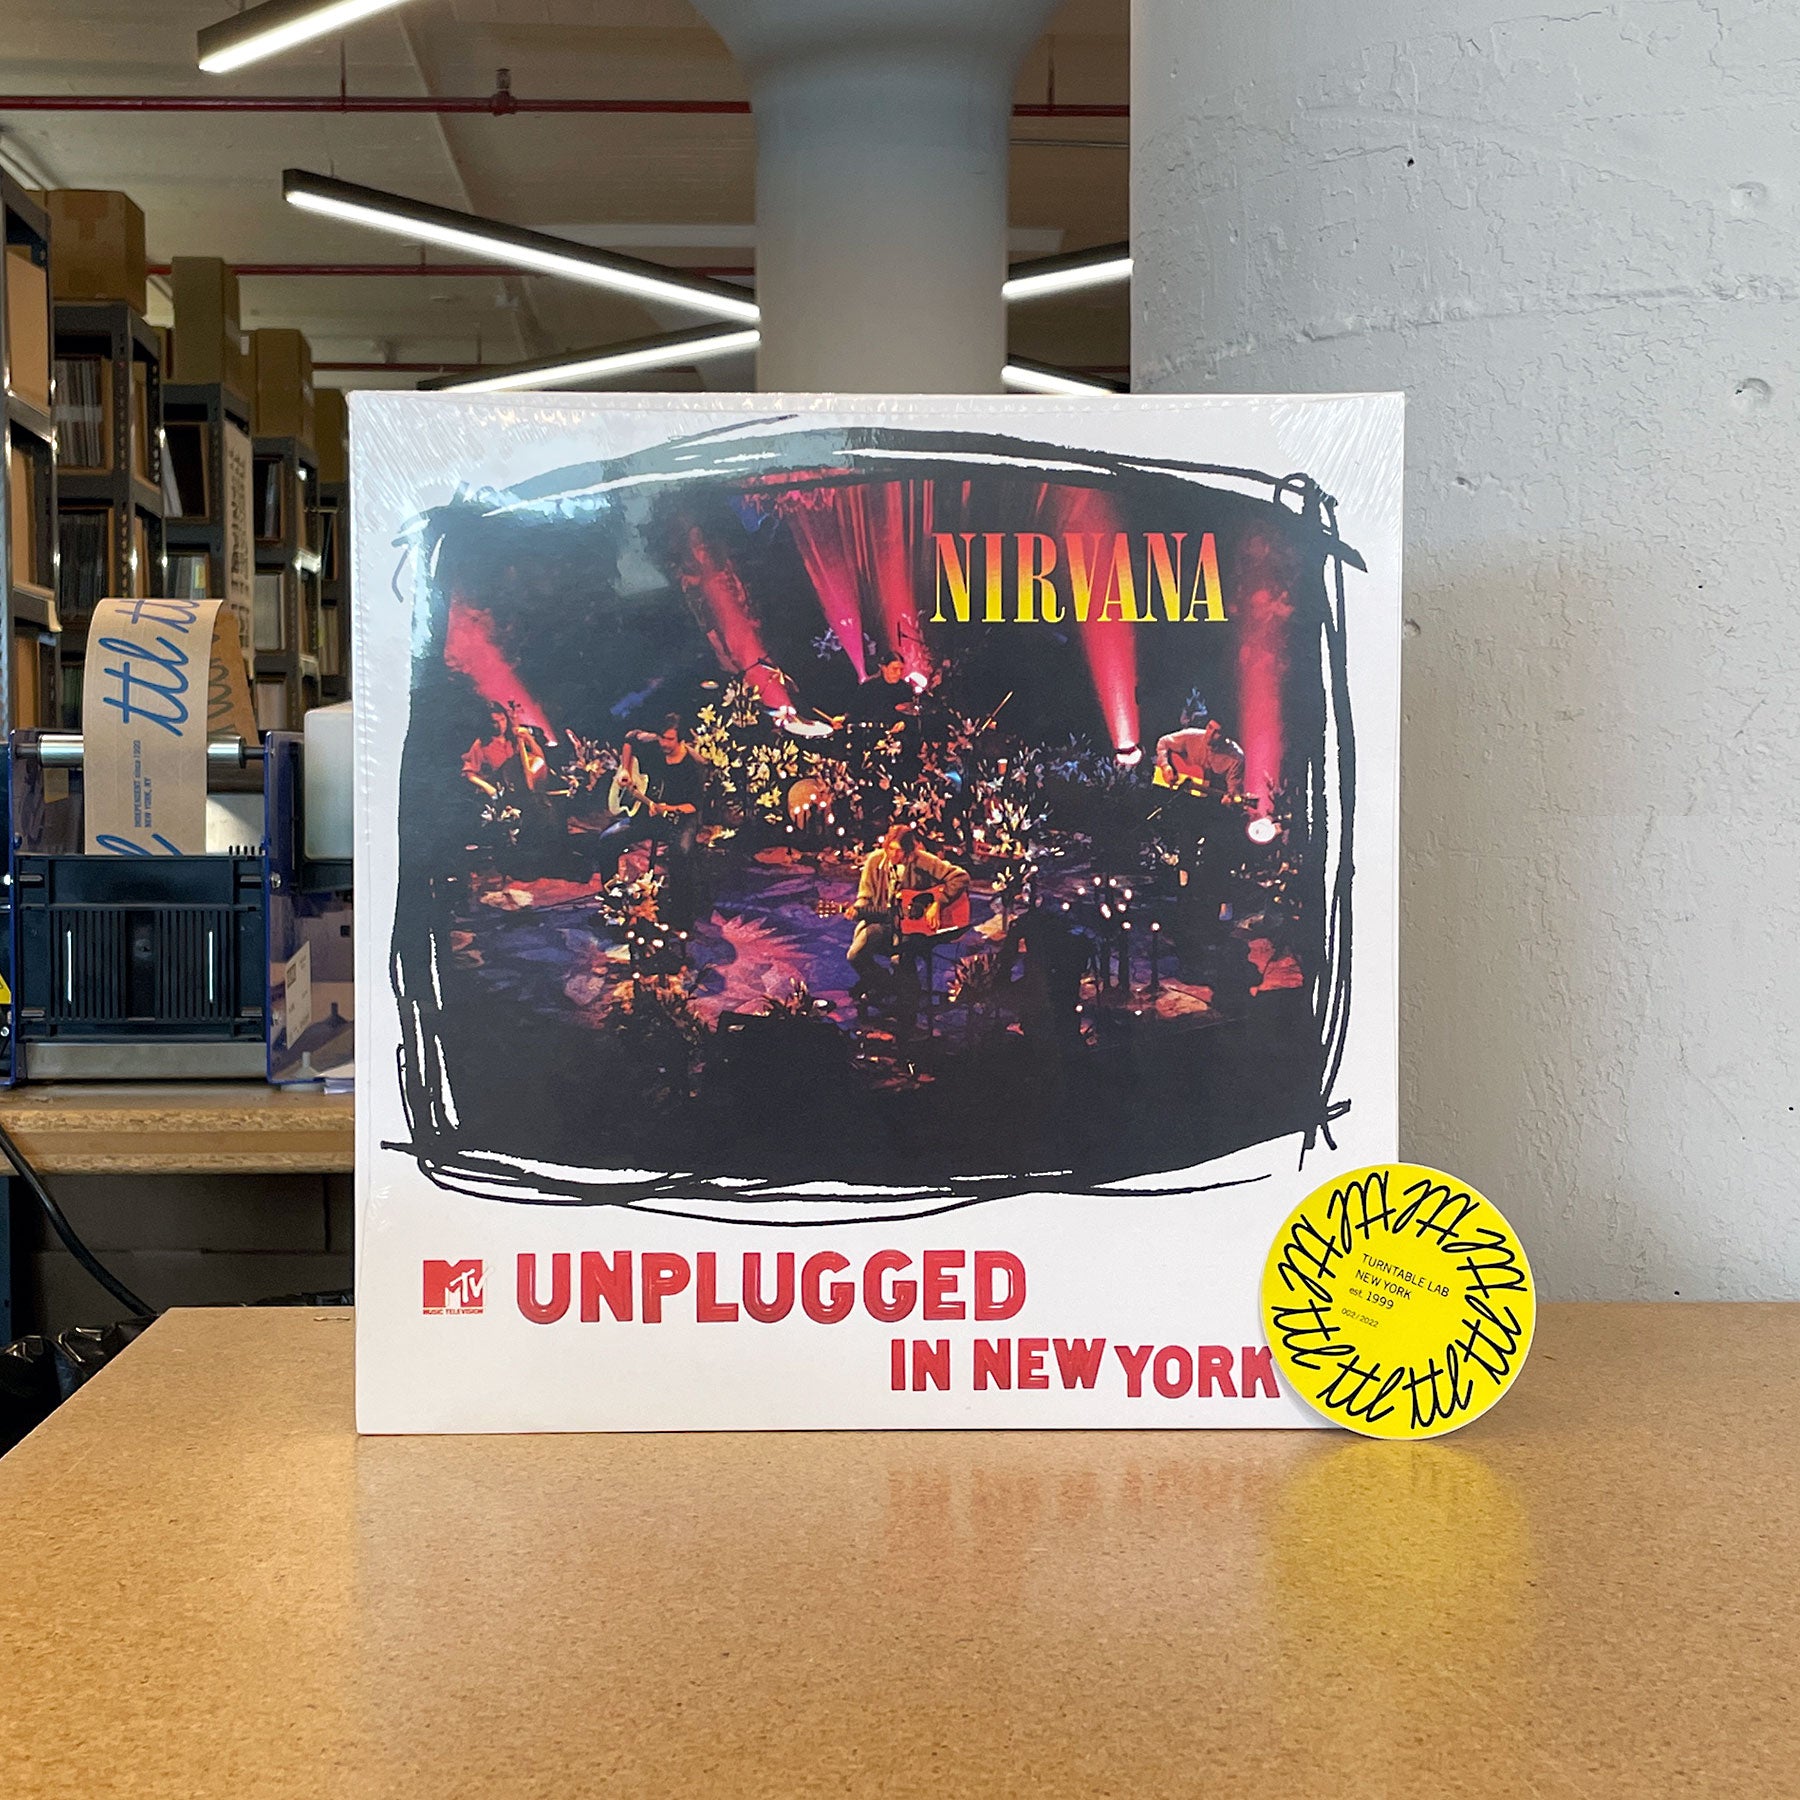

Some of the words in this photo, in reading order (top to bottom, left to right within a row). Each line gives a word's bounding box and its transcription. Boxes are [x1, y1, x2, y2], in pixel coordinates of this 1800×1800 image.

[930, 532, 1229, 623] NIRVANA
[98, 636, 189, 737] ttl
[422, 1259, 486, 1307] MTV
[516, 1249, 1027, 1325] UNPLUGGED
[1355, 1269, 1382, 1287] NEW
[1383, 1280, 1412, 1300] YORK
[1362, 1253, 1426, 1288] TURNTABLE
[1427, 1281, 1450, 1297] LAB
[1366, 1291, 1394, 1310] 1999
[891, 1338, 951, 1392] IN
[973, 1337, 1107, 1391] NEW
[1113, 1344, 1281, 1399] YORK
